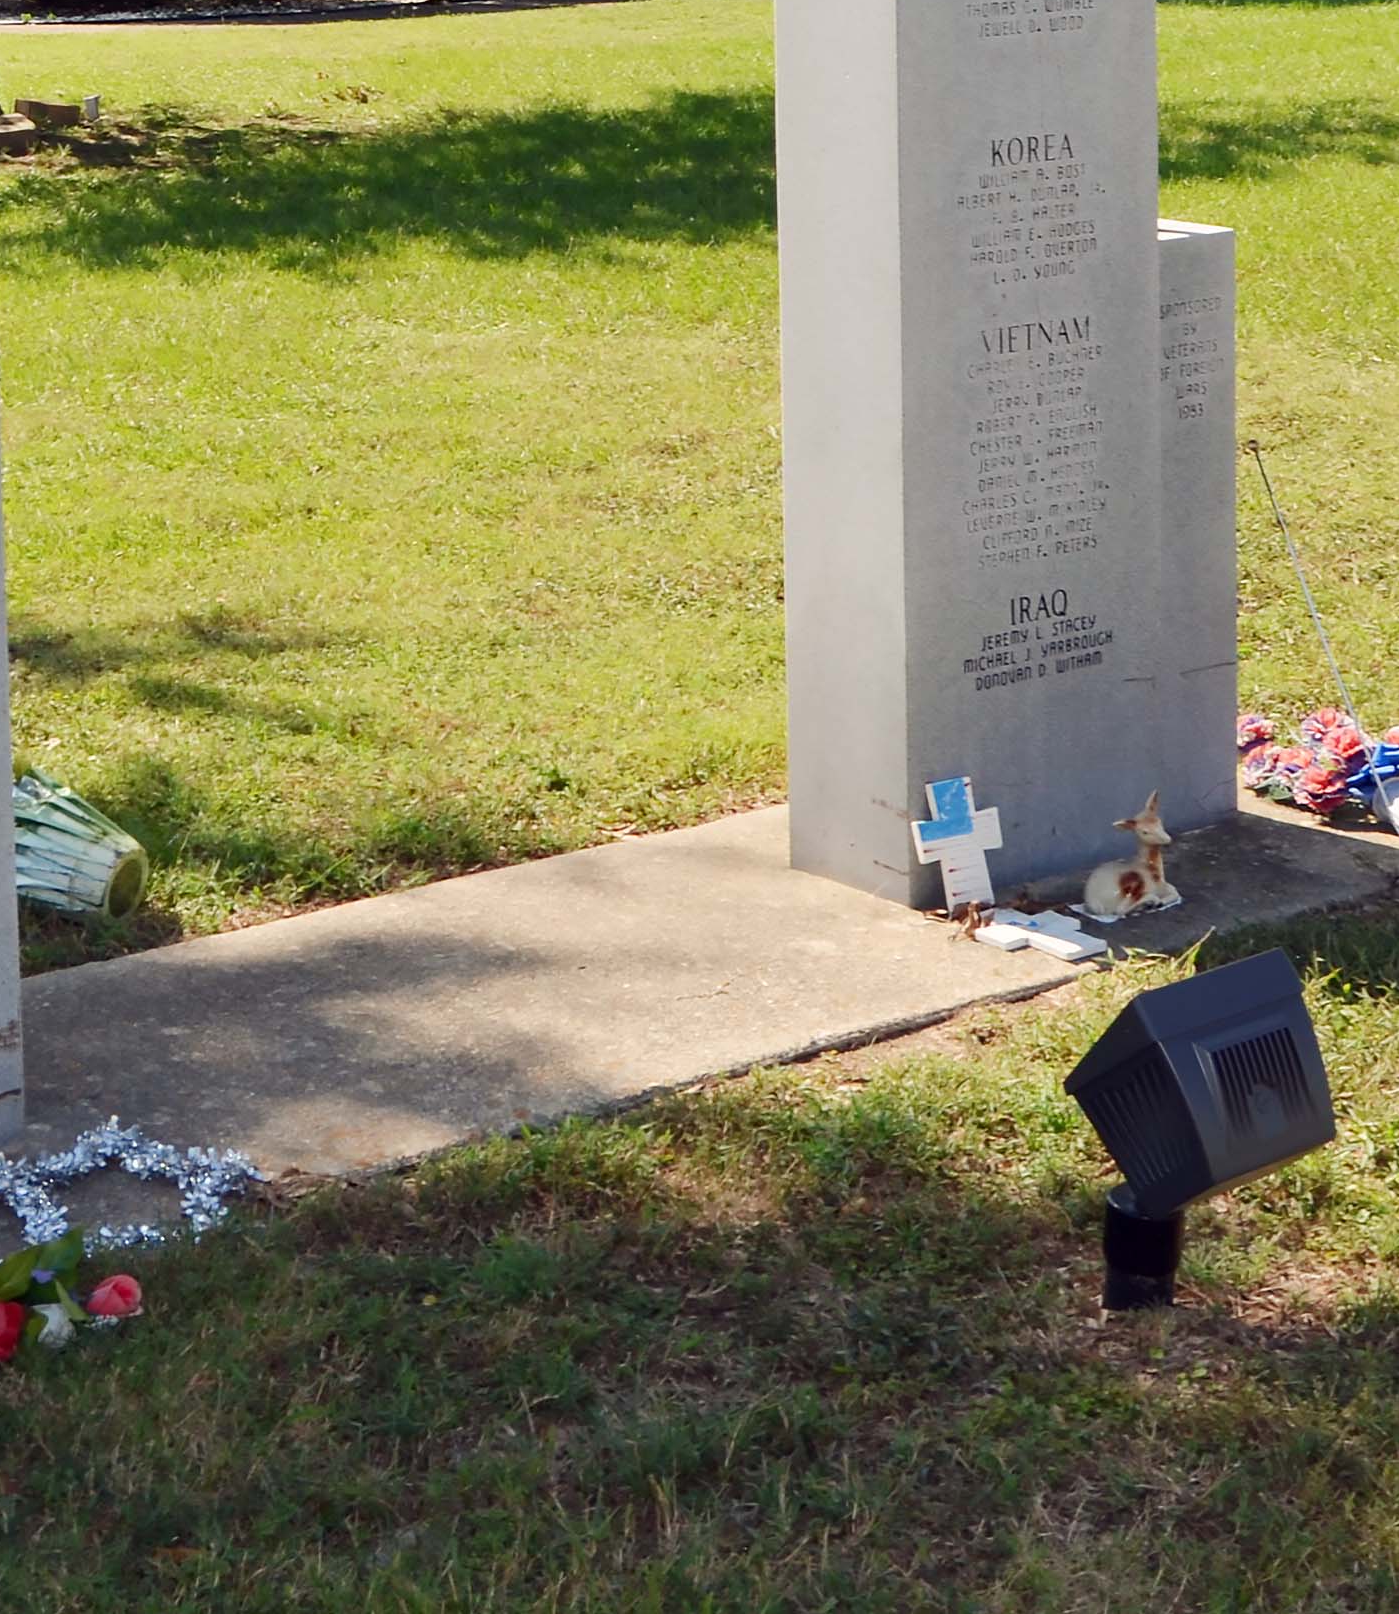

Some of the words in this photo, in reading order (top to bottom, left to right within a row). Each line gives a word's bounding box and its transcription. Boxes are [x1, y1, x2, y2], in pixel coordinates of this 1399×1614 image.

[1011, 590, 1068, 626] IRAQ
[964, 652, 1016, 673] MICHAEL
[1025, 650, 1030, 661] J
[1041, 630, 1113, 657] YARBROUGH
[981, 629, 1027, 652] JEREMY
[1036, 626, 1041, 640] L
[1052, 615, 1096, 636] STACEY
[976, 666, 1031, 691] DONOVAN
[1039, 664, 1045, 677] D
[1056, 651, 1102, 674] WITHAM
